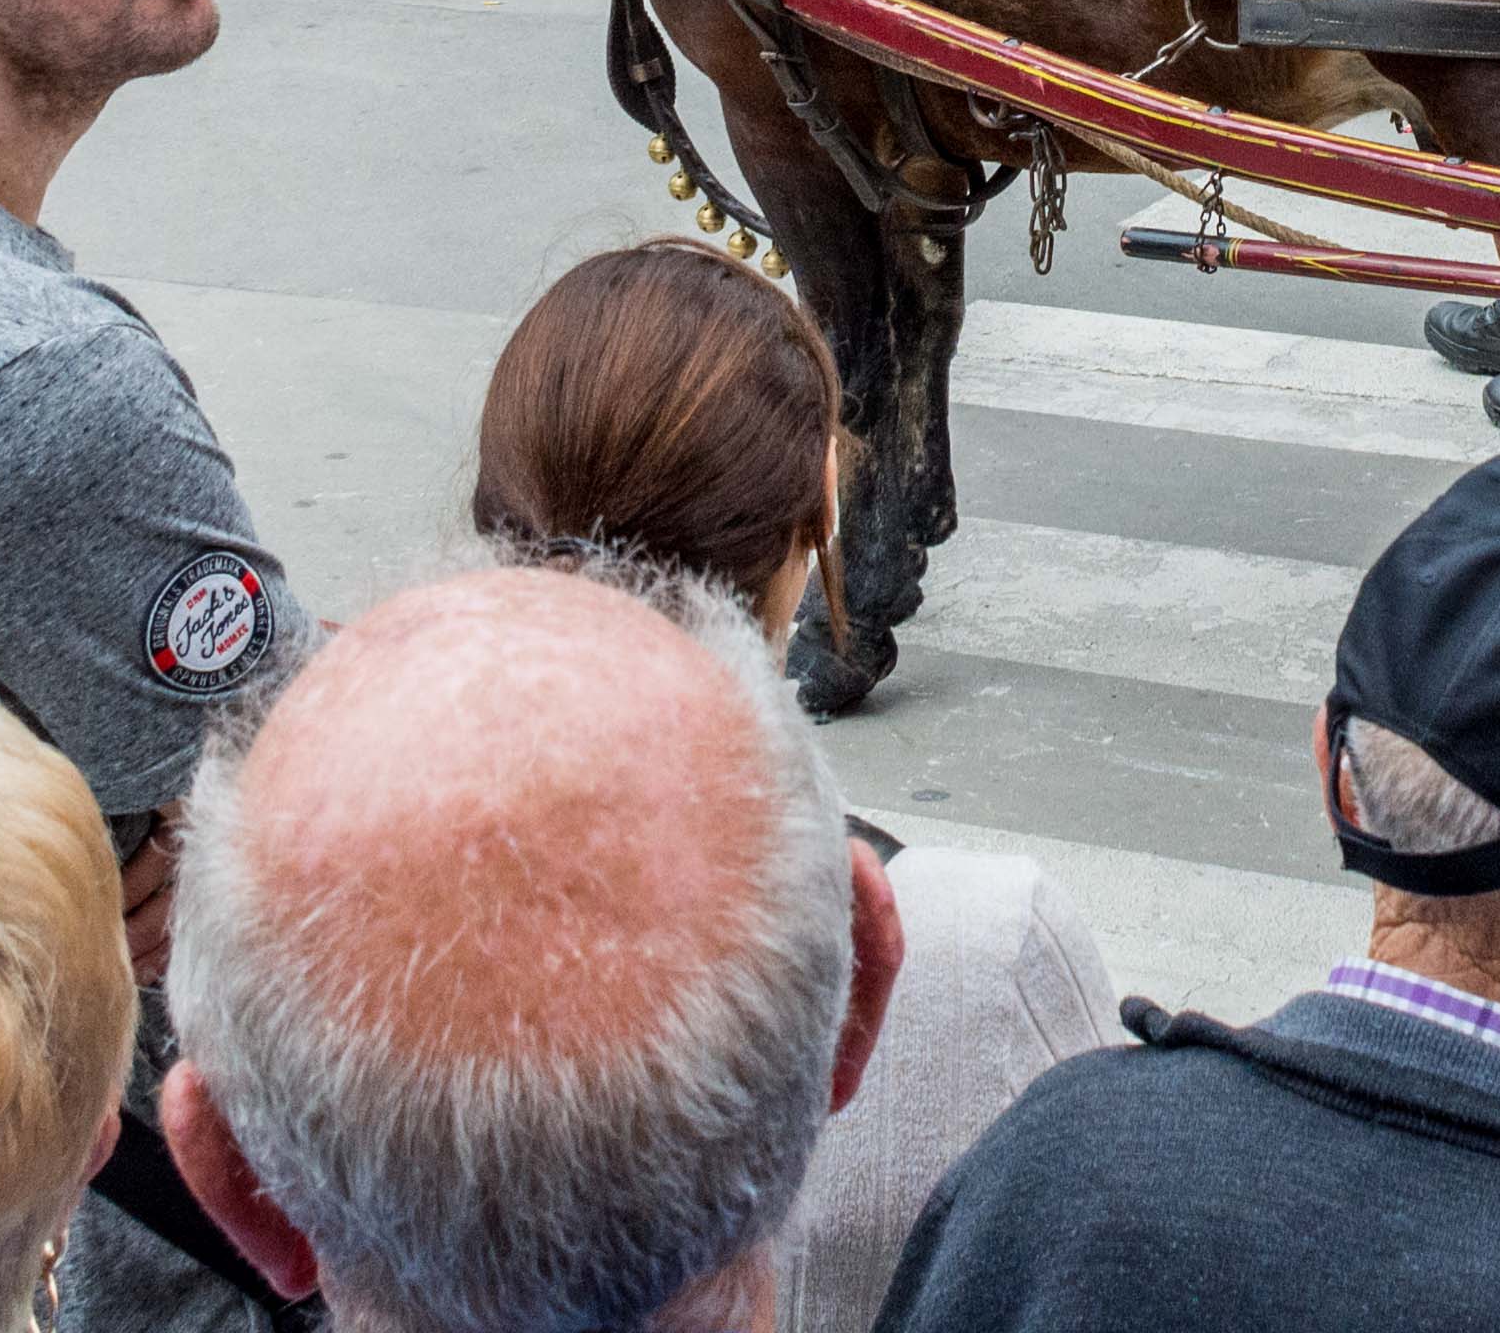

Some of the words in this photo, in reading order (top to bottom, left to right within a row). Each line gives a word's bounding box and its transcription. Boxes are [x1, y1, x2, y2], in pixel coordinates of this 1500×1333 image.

[184, 557, 244, 587] TRADEMARK
[174, 588, 224, 659] Jack
[224, 585, 237, 602] &
[200, 593, 251, 660] Jones
